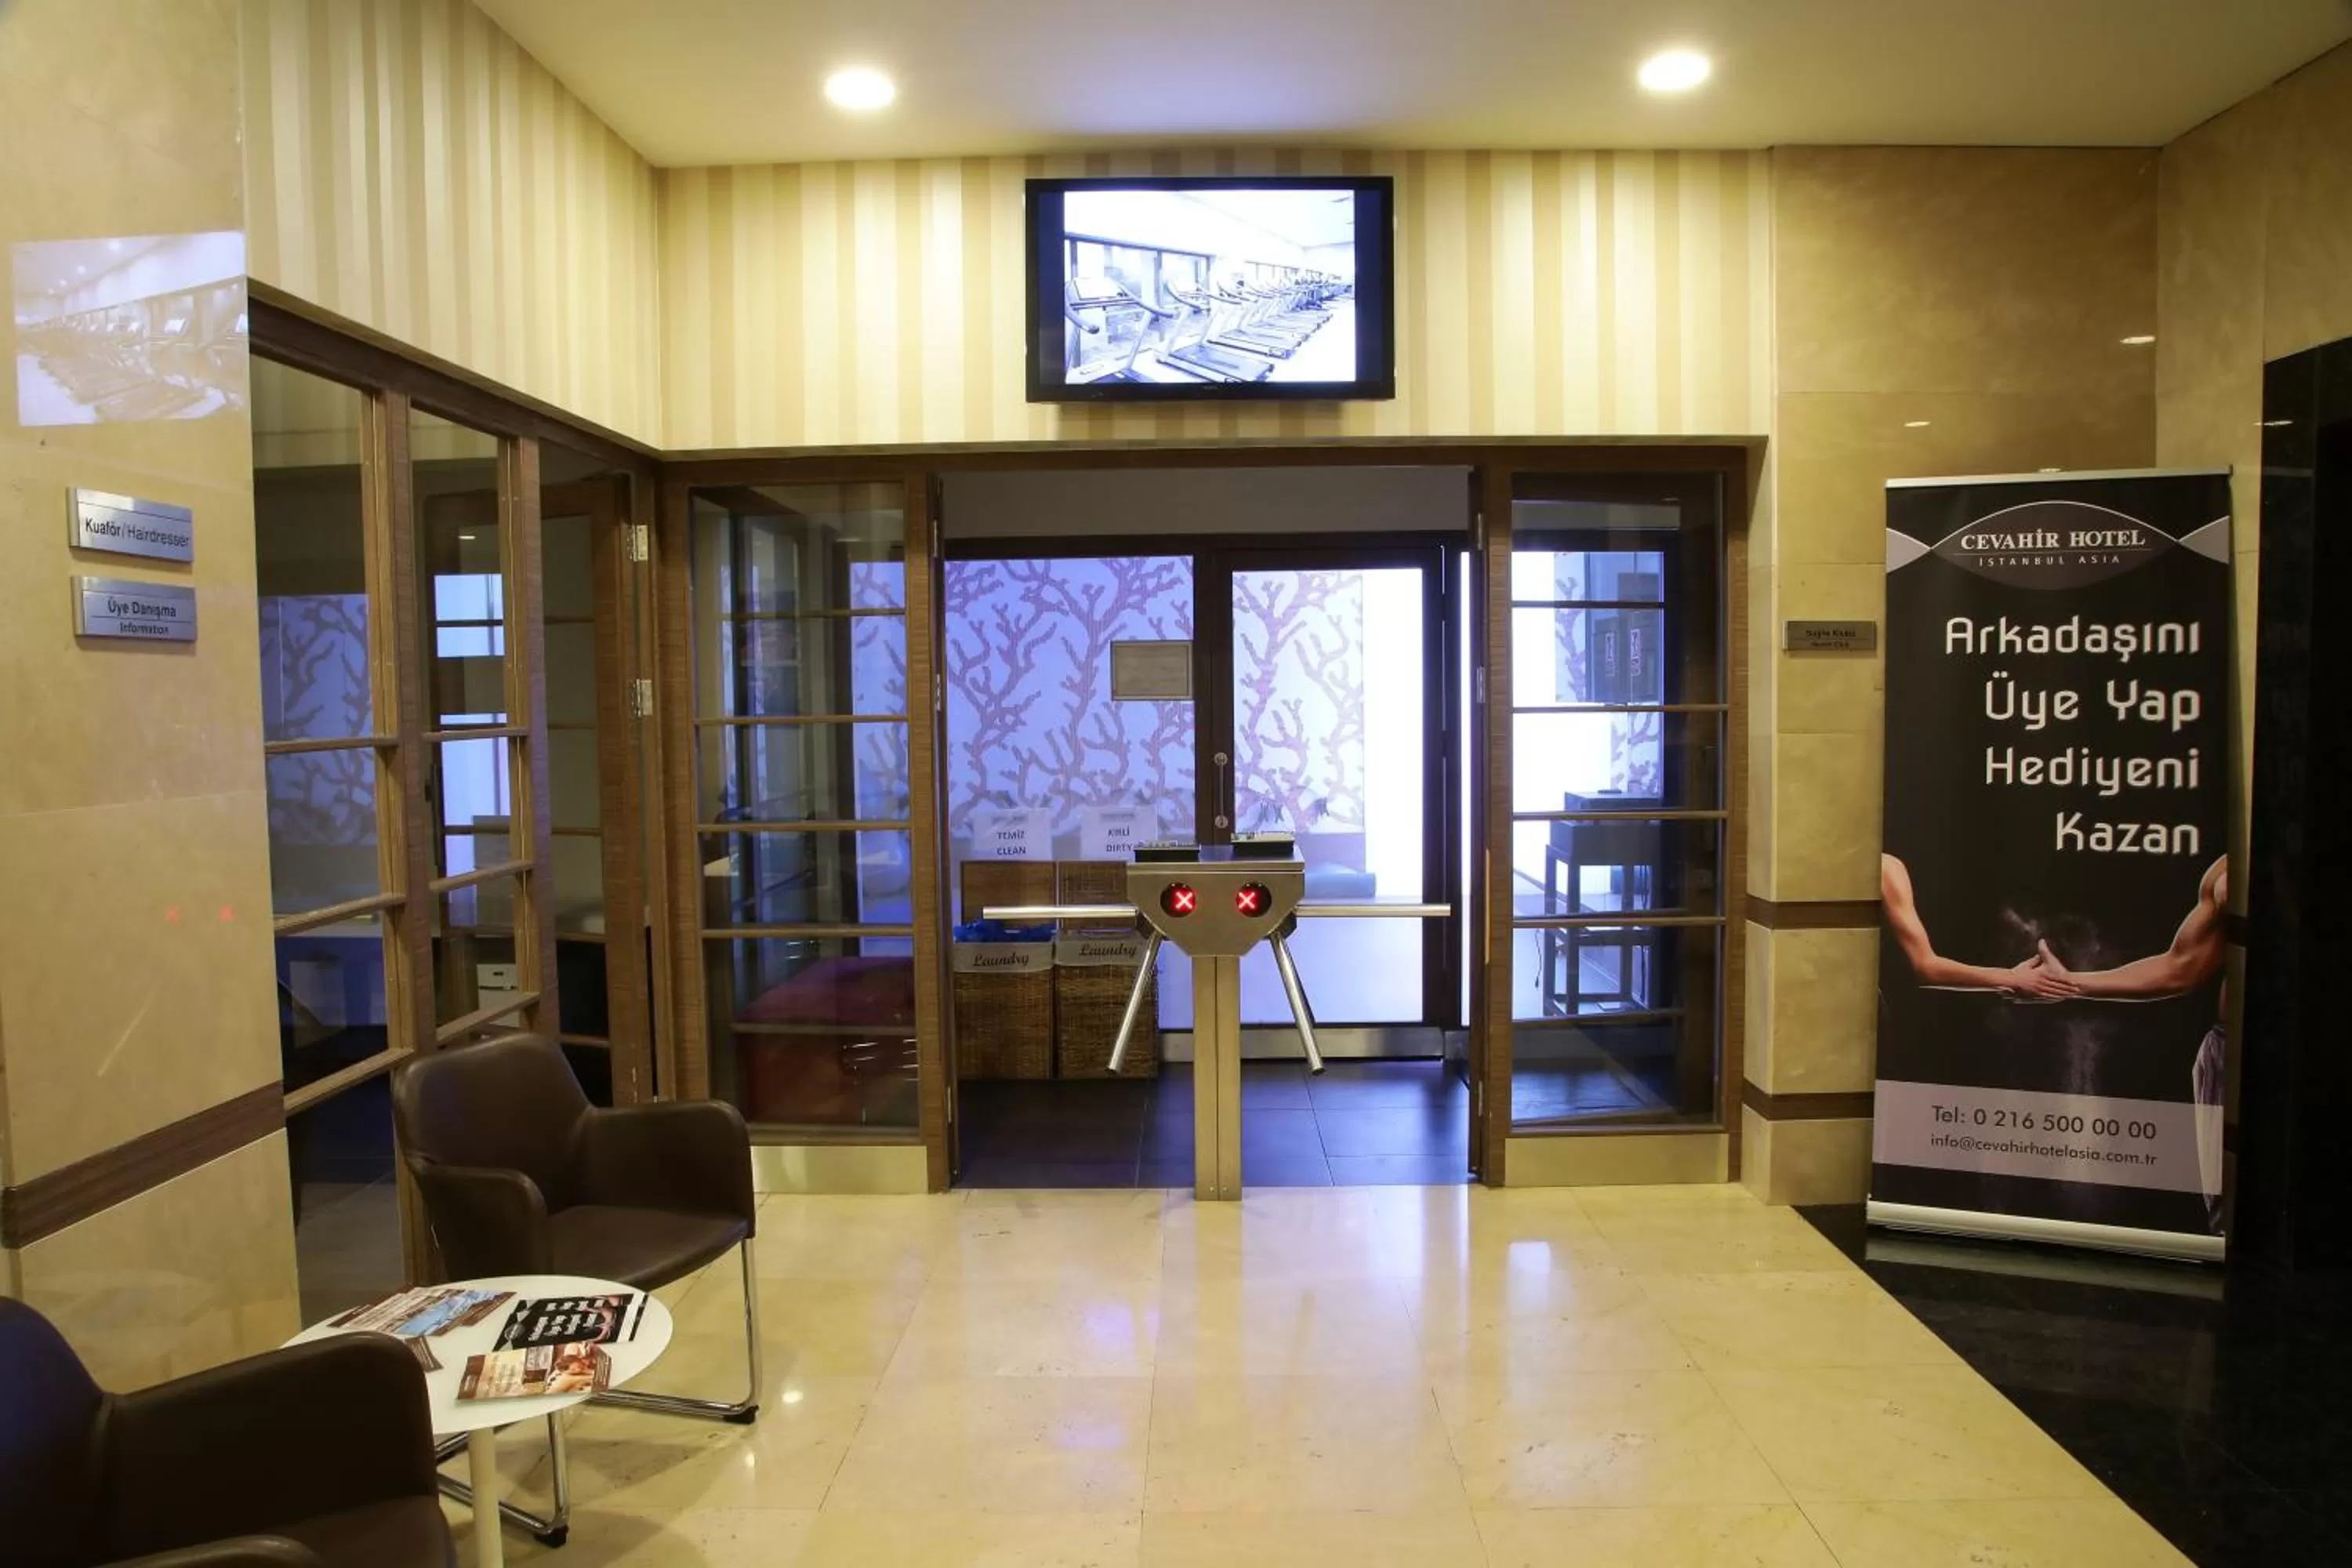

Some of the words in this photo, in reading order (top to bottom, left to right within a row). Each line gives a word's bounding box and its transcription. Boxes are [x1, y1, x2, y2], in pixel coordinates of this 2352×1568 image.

[1961, 528, 2060, 549] CEVAHİR
[2070, 529, 2146, 547] HOTEL
[2078, 554, 2120, 564] ASIA
[1945, 615, 2201, 662] Arkadaşını
[1986, 670, 2079, 731] Üye
[2107, 678, 2201, 733] Yap
[1985, 746, 2200, 796] Hediyeni
[2056, 811, 2200, 855] Kazan
[996, 845, 1026, 856] CLEAN
[1106, 843, 1134, 853] DIRTY
[973, 953, 1030, 967] Laundry
[1079, 943, 1138, 959] Laundry
[1931, 1105, 1965, 1123] Tel:
[1973, 1108, 1987, 1125] 0
[1993, 1109, 2034, 1130] 216
[2042, 1113, 2084, 1134] 500
[2092, 1117, 2120, 1137] 00
[2128, 1120, 2156, 1140] 00
[1930, 1133, 2158, 1166] info@cevahirhotelasia.com.tr
